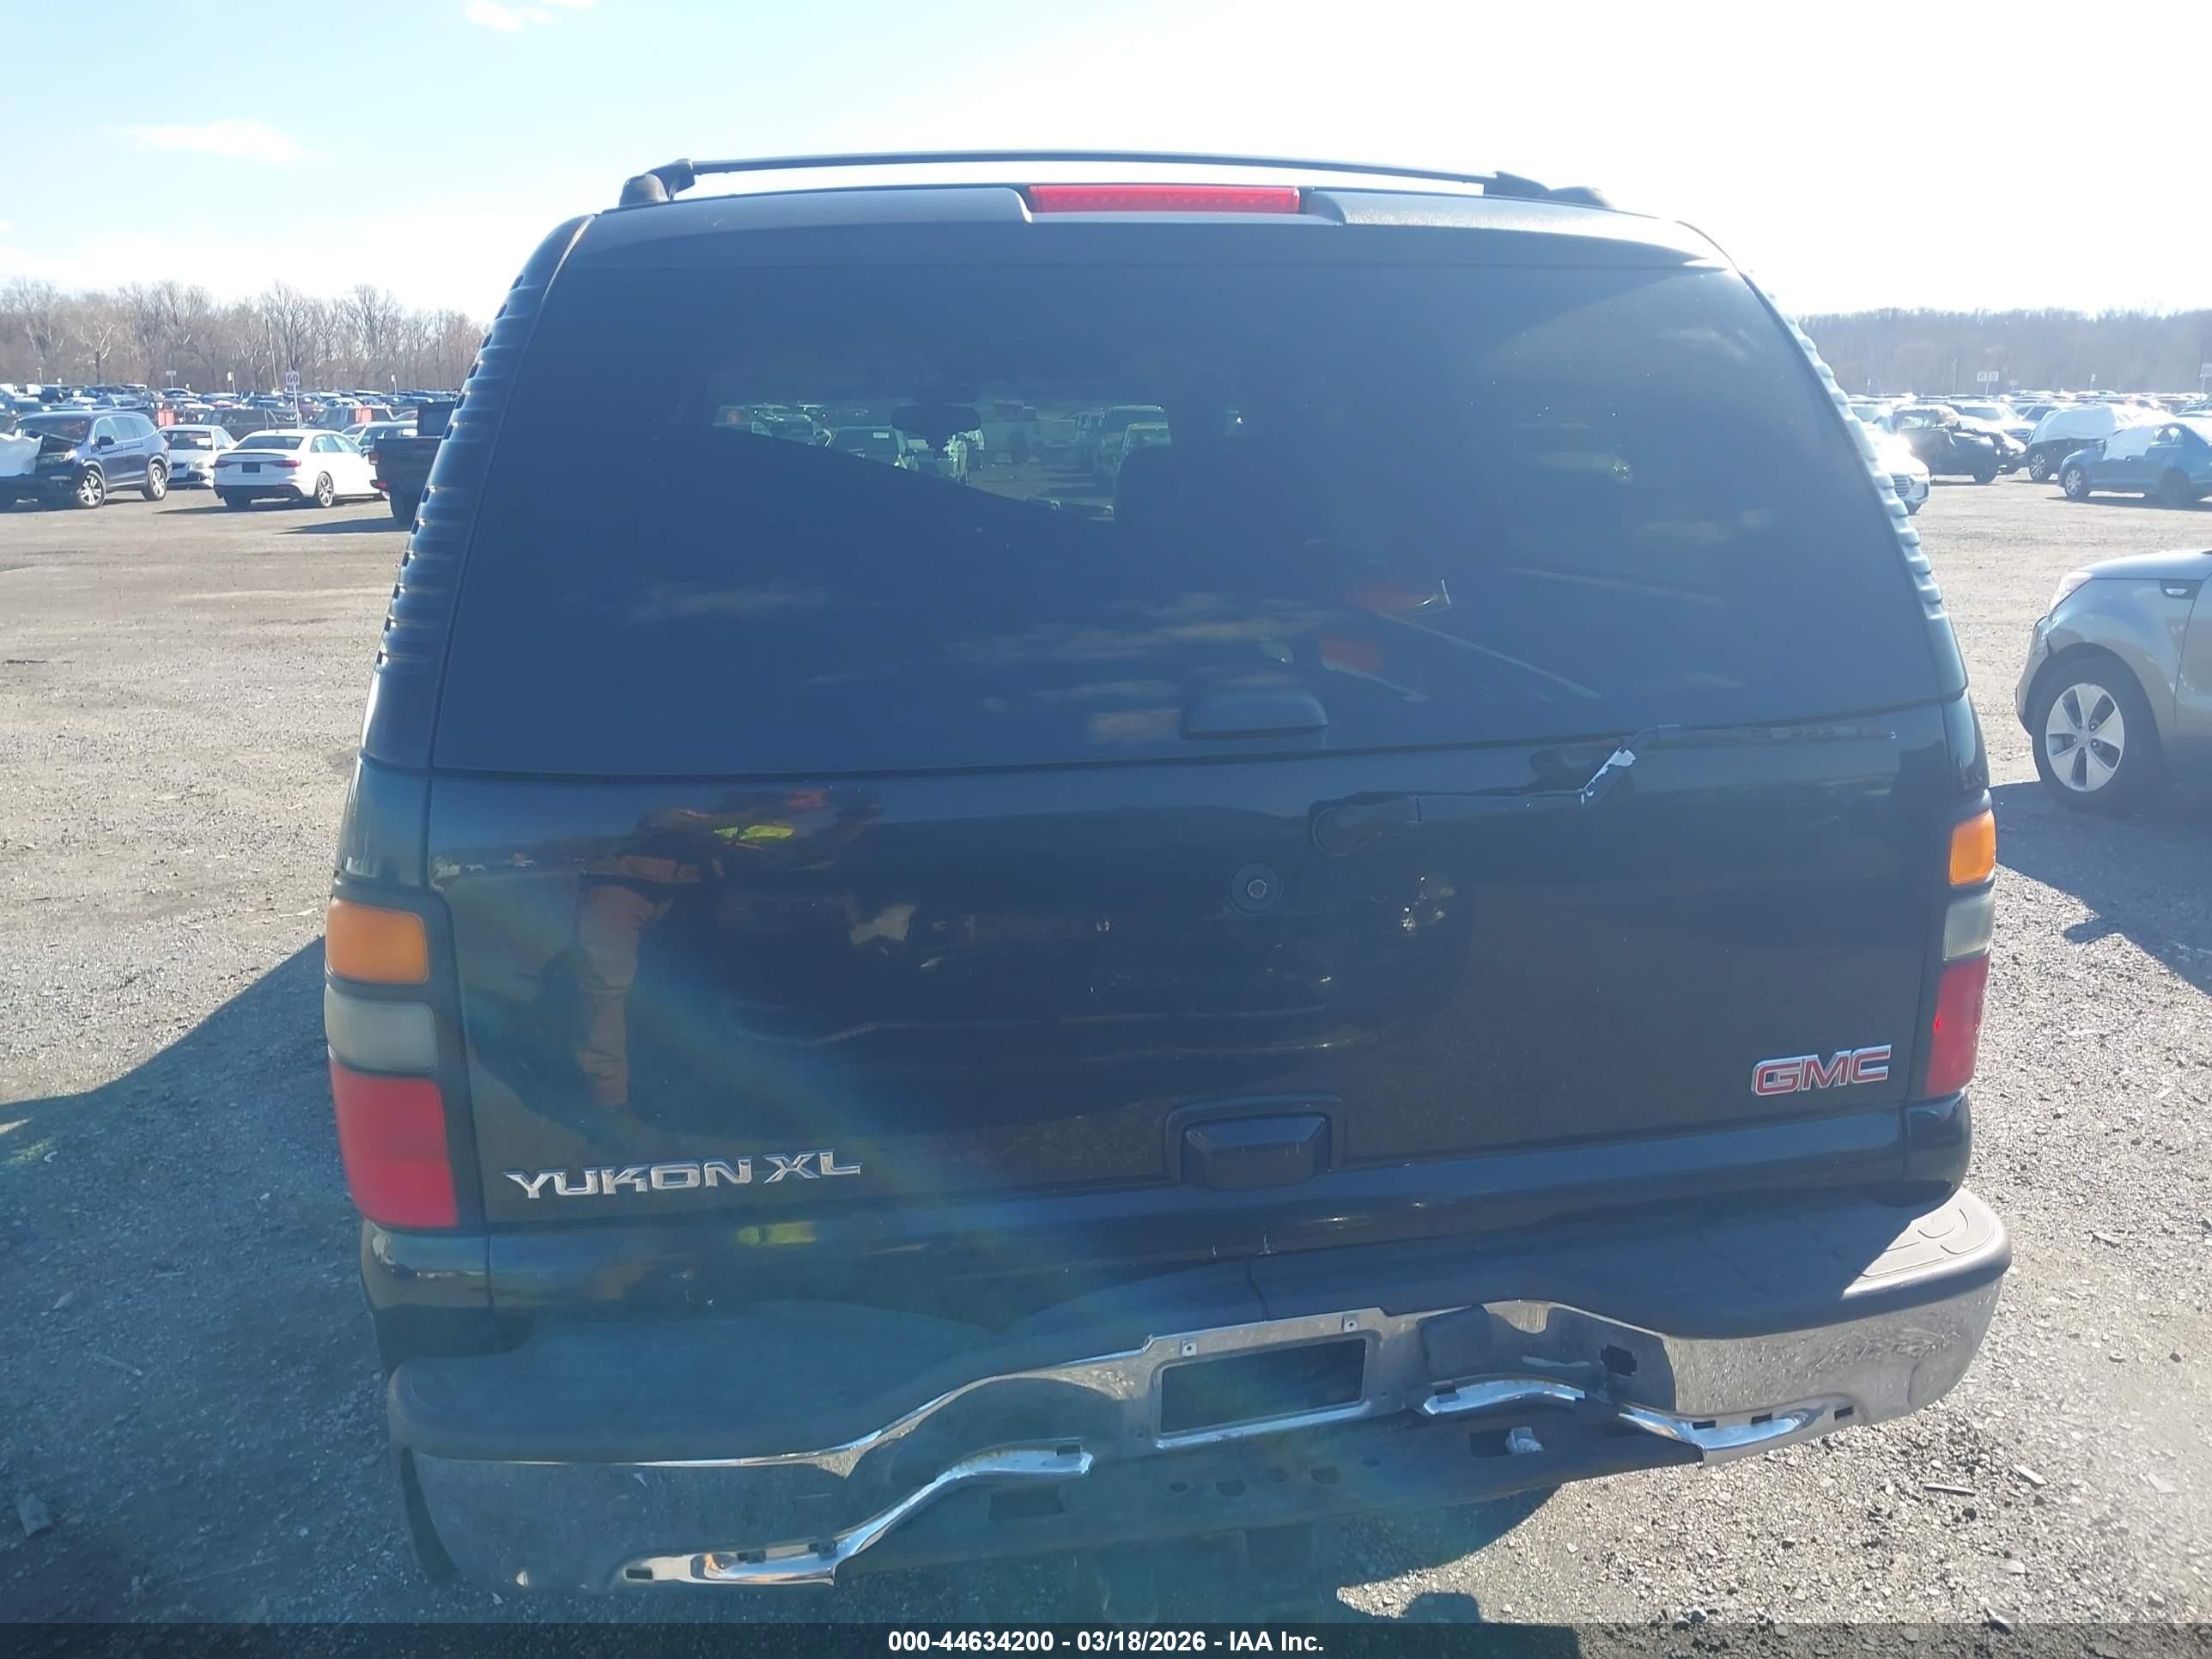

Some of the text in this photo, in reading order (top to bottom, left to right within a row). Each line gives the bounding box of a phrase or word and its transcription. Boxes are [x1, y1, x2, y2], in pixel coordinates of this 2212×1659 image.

[1751, 1044, 1893, 1096] GMC
[505, 1149, 861, 1199] YUKON XL
